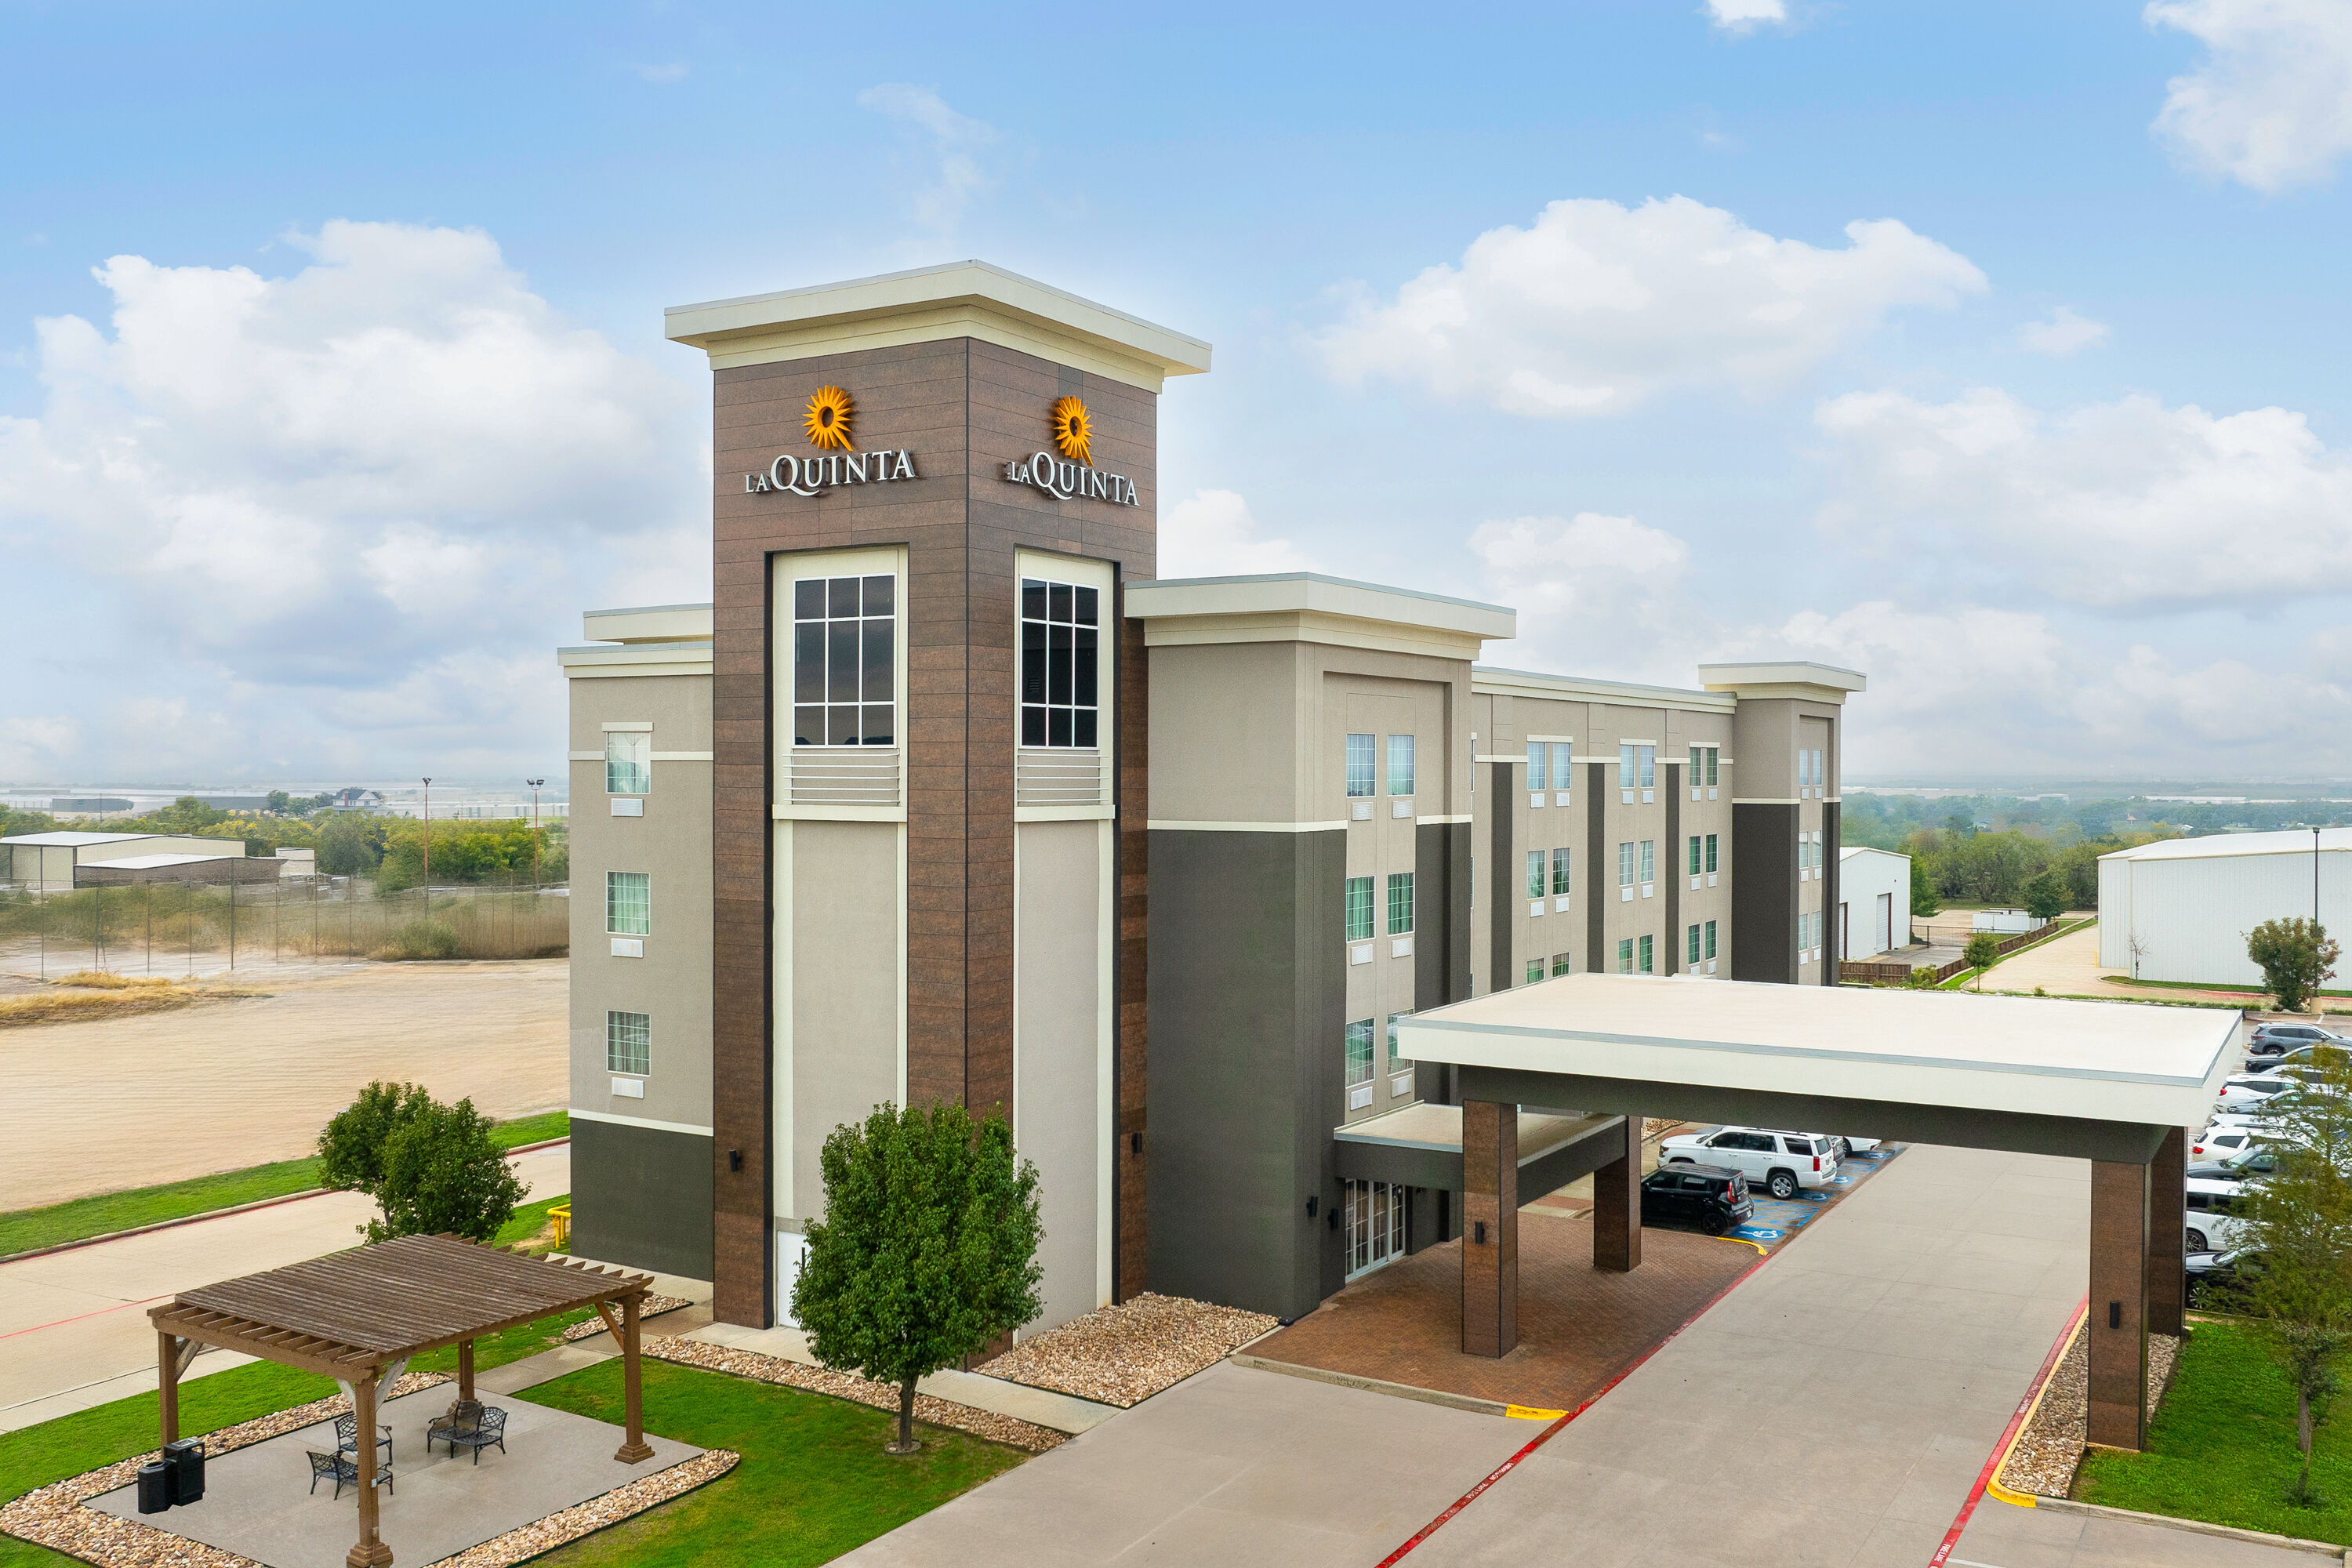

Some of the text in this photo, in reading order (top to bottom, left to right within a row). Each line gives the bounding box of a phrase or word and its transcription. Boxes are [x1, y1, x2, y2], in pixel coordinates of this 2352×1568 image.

[746, 448, 916, 496] LA QUINTA
[1032, 451, 1141, 506] QUINTA
